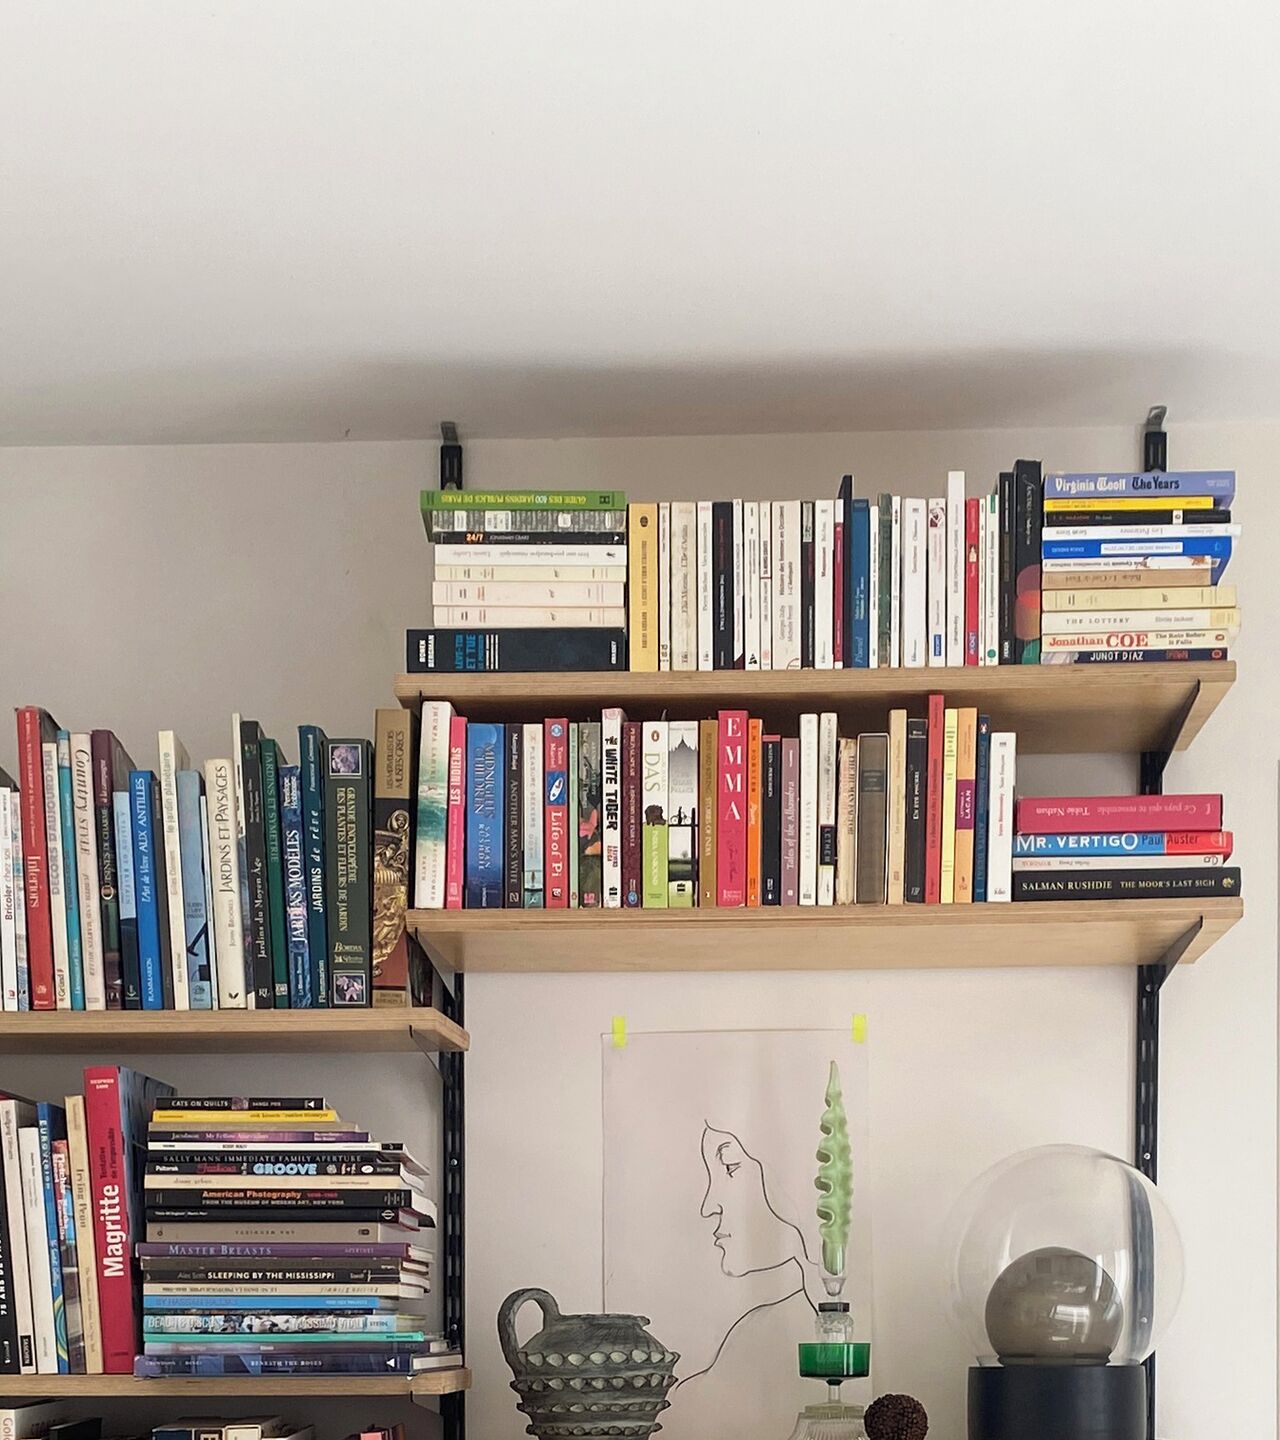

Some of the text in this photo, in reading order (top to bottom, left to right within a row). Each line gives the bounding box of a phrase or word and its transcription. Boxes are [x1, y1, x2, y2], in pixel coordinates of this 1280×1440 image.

[1056, 477, 1180, 494] Virginia Woolf The Years
[466, 533, 484, 542] 24/7
[1050, 633, 1148, 648] Jonathan COE
[644, 752, 660, 792] DAS
[726, 717, 742, 821] EMMA
[1017, 833, 1200, 851] MR. VERTIGO Paul Auster
[1022, 879, 1215, 890] SALMAN RUSHDIE THE MOOR'S LAST SIGH
[4, 887, 13, 920] Bricoler
[254, 1163, 318, 1175] GROOVE
[246, 1190, 302, 1199] Photography
[102, 1184, 126, 1278] Magritte
[170, 1245, 272, 1255] MASTER BREASTS
